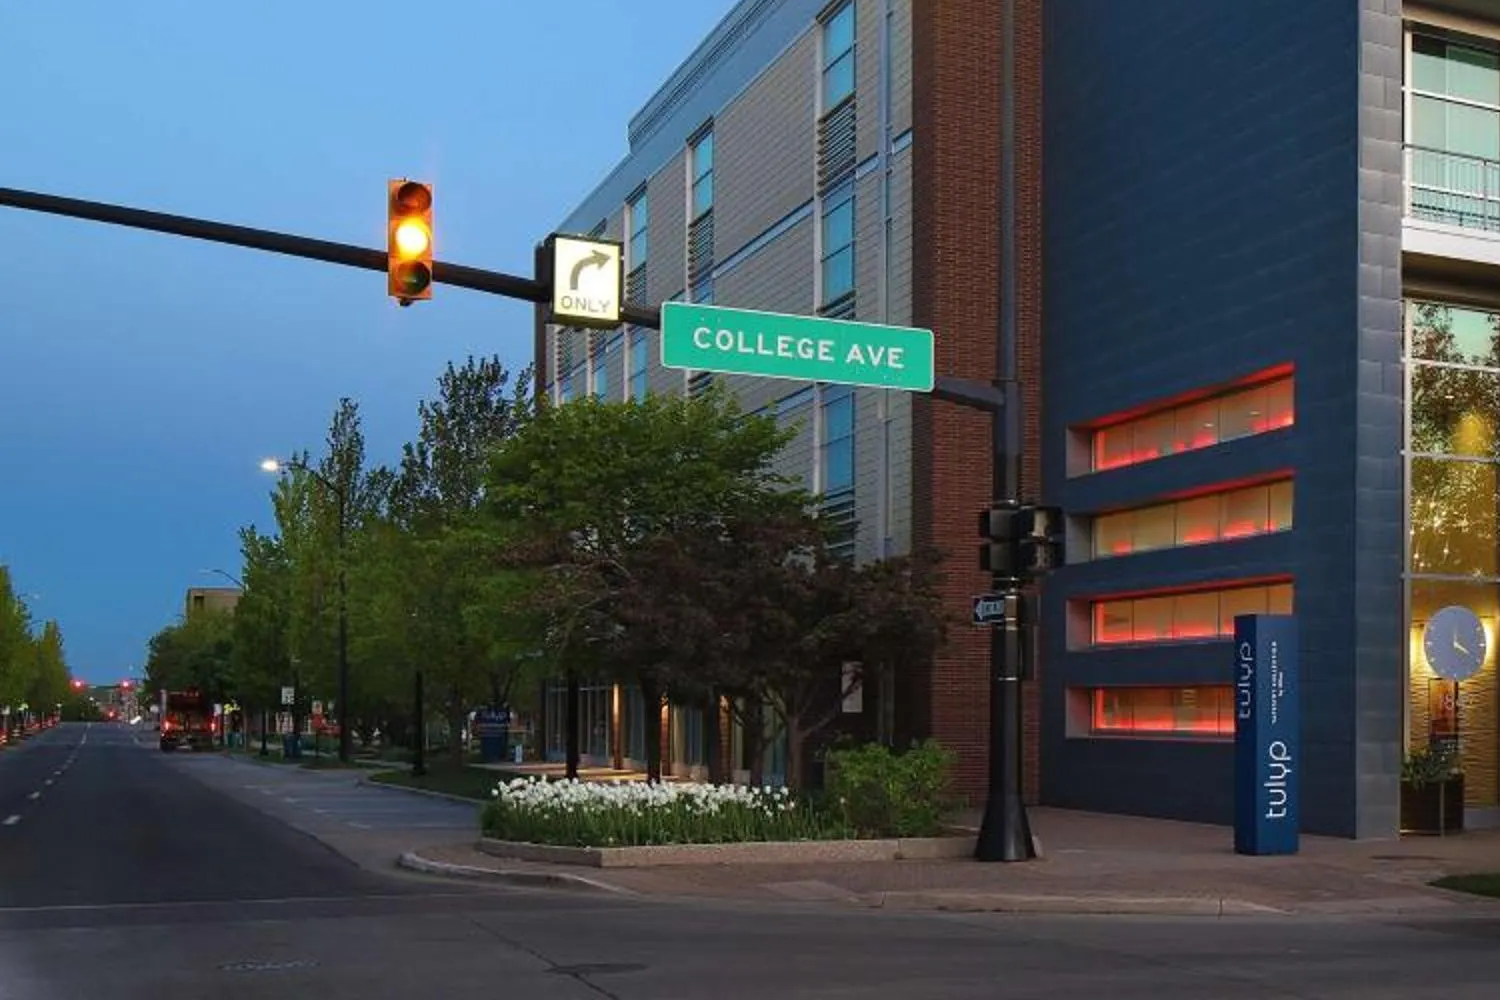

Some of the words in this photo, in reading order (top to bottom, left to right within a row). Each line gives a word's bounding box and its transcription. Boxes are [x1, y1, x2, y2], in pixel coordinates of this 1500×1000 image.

[560, 295, 611, 314] ONLY
[692, 326, 835, 362] COLLEGE
[845, 343, 905, 369] AVE
[1238, 641, 1253, 719] tulyp
[1263, 740, 1292, 819] tulyp
